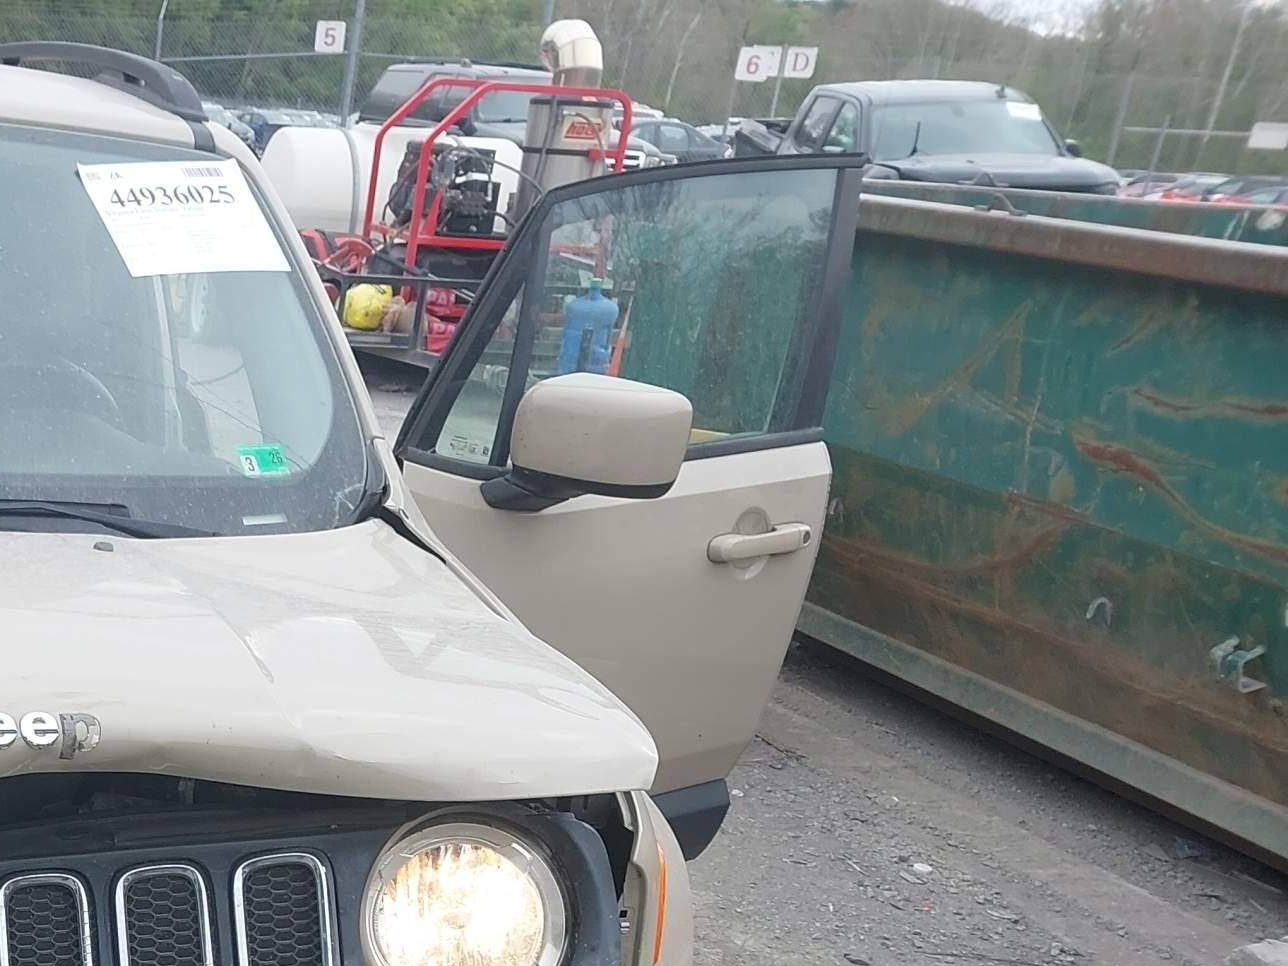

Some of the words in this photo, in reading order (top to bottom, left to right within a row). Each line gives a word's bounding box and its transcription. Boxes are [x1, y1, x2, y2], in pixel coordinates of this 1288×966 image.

[324, 27, 337, 47] 5
[746, 54, 761, 74] 6
[792, 52, 810, 72] D
[109, 184, 236, 208] 44936025
[244, 456, 256, 472] 3
